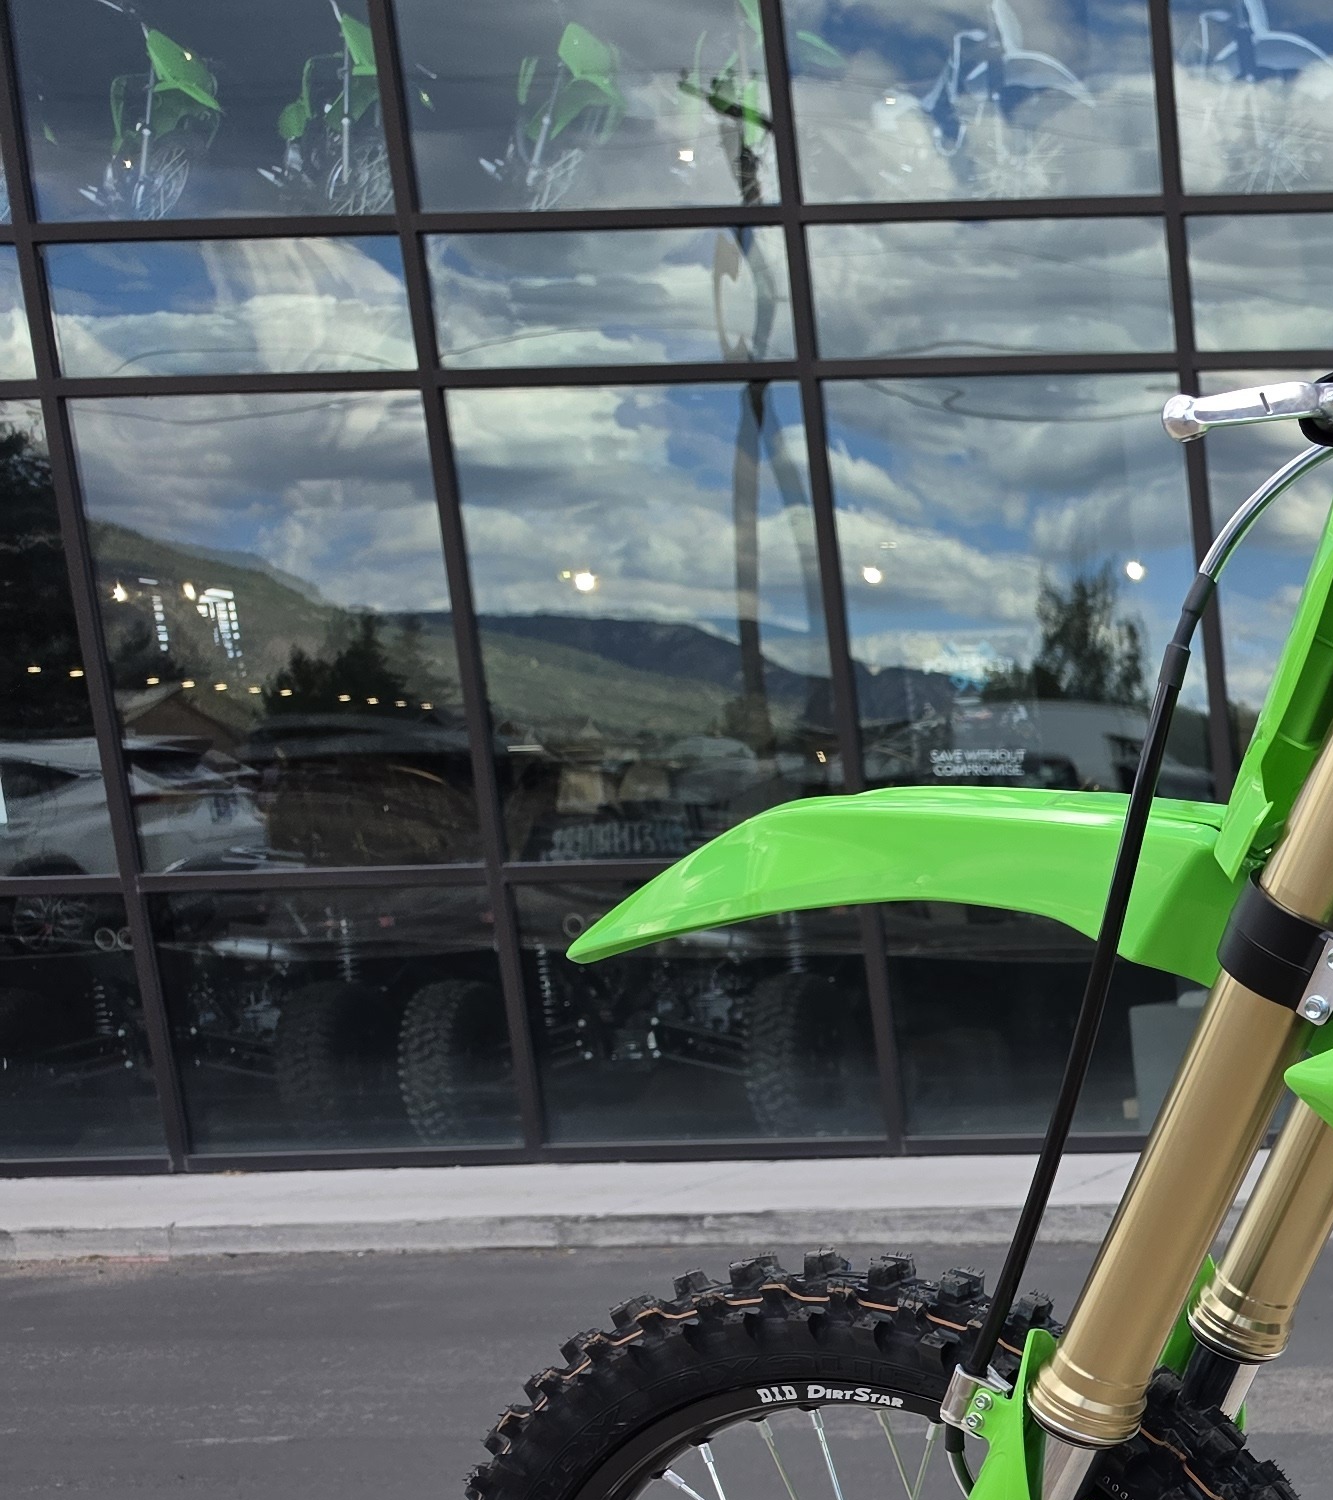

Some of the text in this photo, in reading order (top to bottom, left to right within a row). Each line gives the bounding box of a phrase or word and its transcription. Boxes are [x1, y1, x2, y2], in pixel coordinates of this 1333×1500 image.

[929, 748, 1027, 763] SAVE WITHOUT
[755, 1386, 799, 1405] D.I.D
